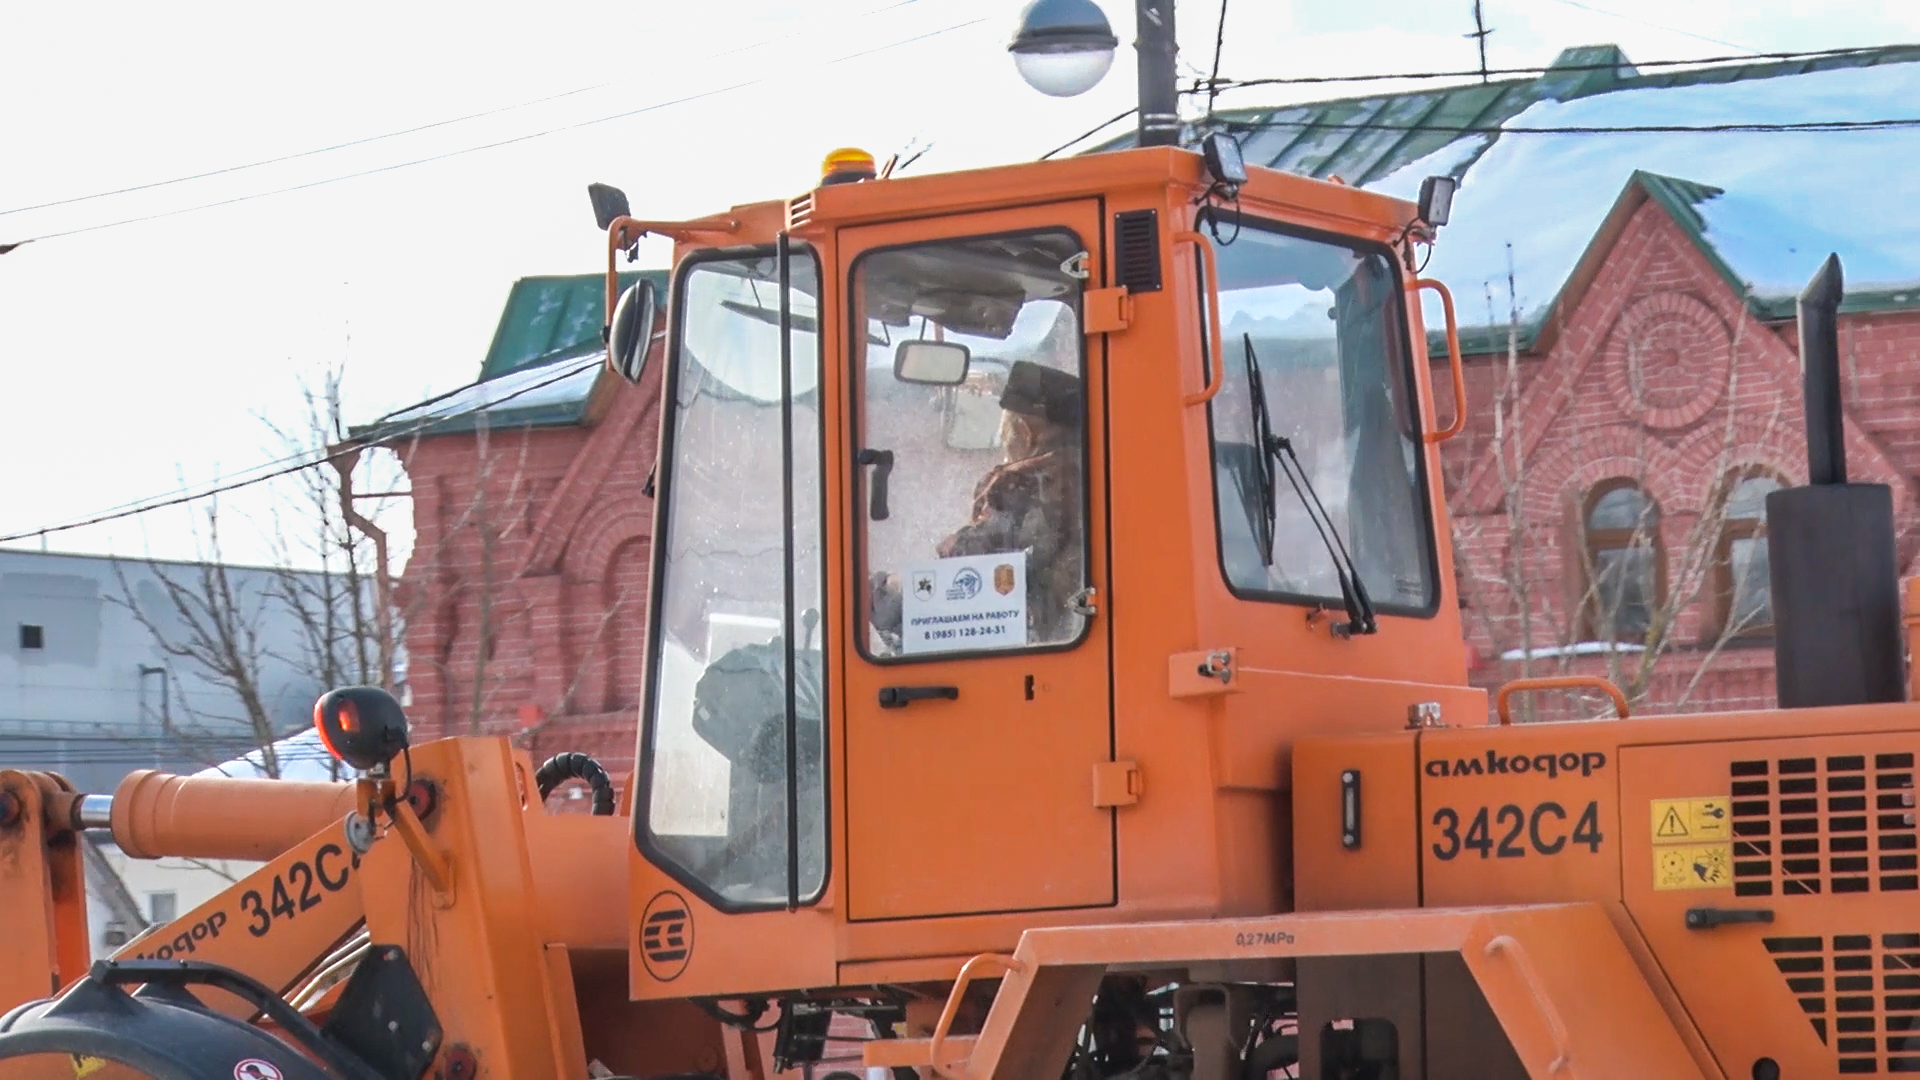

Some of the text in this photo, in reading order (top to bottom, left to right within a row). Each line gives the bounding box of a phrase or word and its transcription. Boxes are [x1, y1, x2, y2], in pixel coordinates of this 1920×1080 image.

[911, 609, 1020, 626] ПРИГЛАШАЕМ НА РАБОТУ
[924, 625, 1006, 640] 8 (985) 128-24-31
[240, 843, 361, 938] 342C
